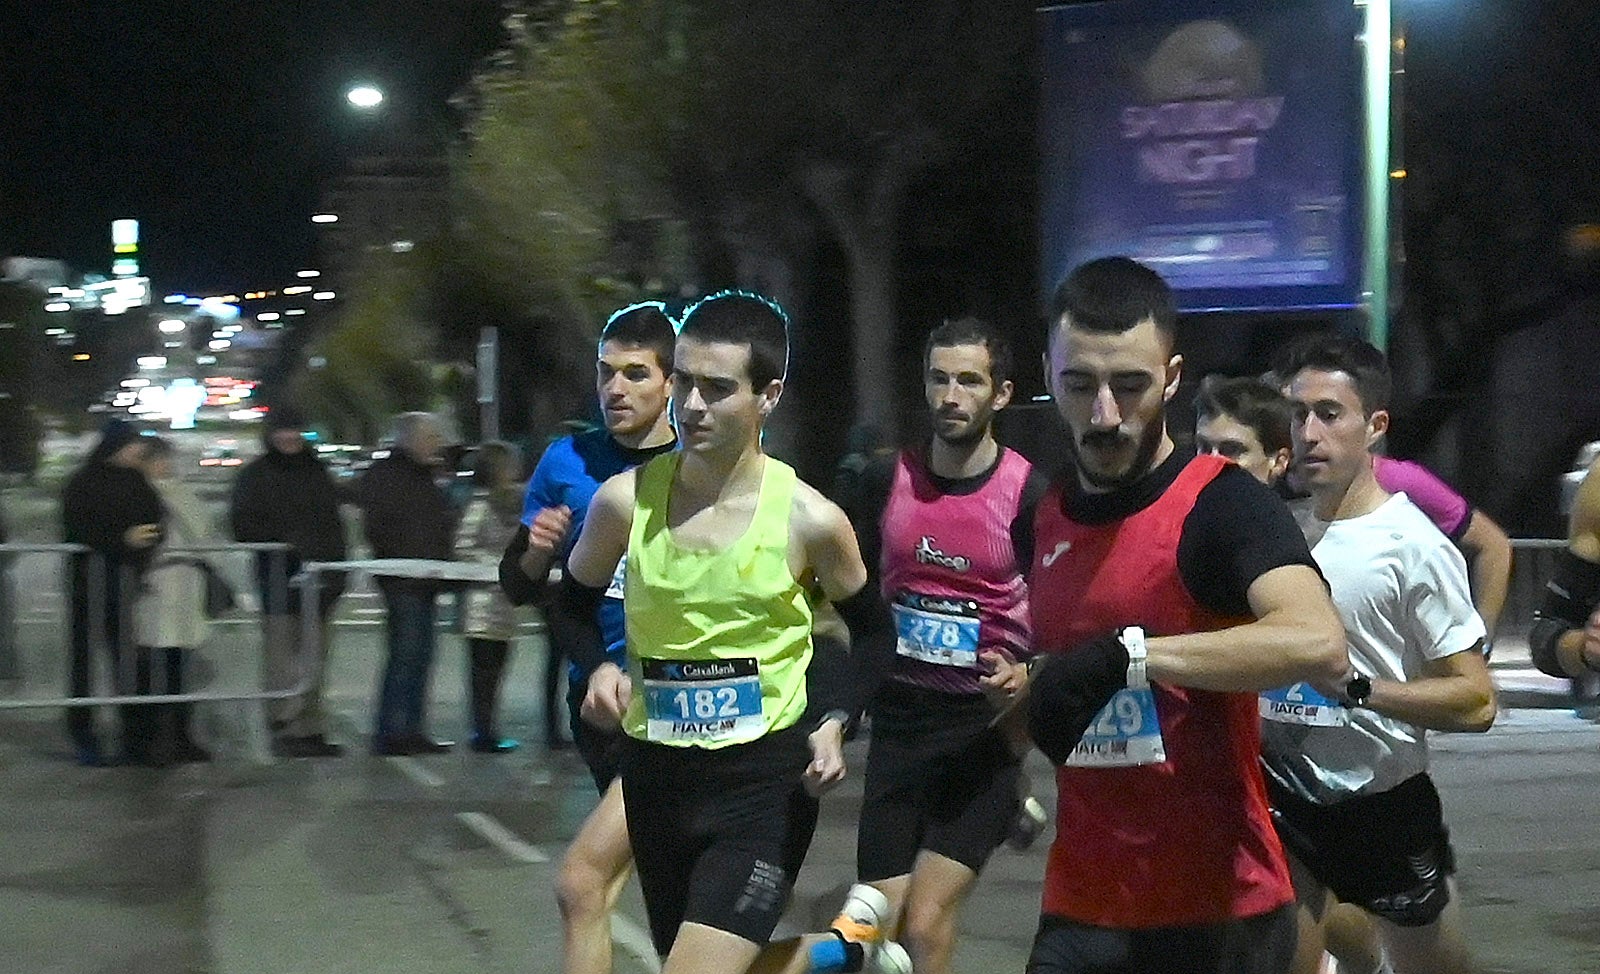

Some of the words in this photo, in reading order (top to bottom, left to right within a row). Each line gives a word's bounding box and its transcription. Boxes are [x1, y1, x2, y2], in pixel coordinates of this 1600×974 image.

[909, 618, 960, 647] 278
[683, 663, 736, 677] CaixaBank
[673, 687, 741, 719] 182
